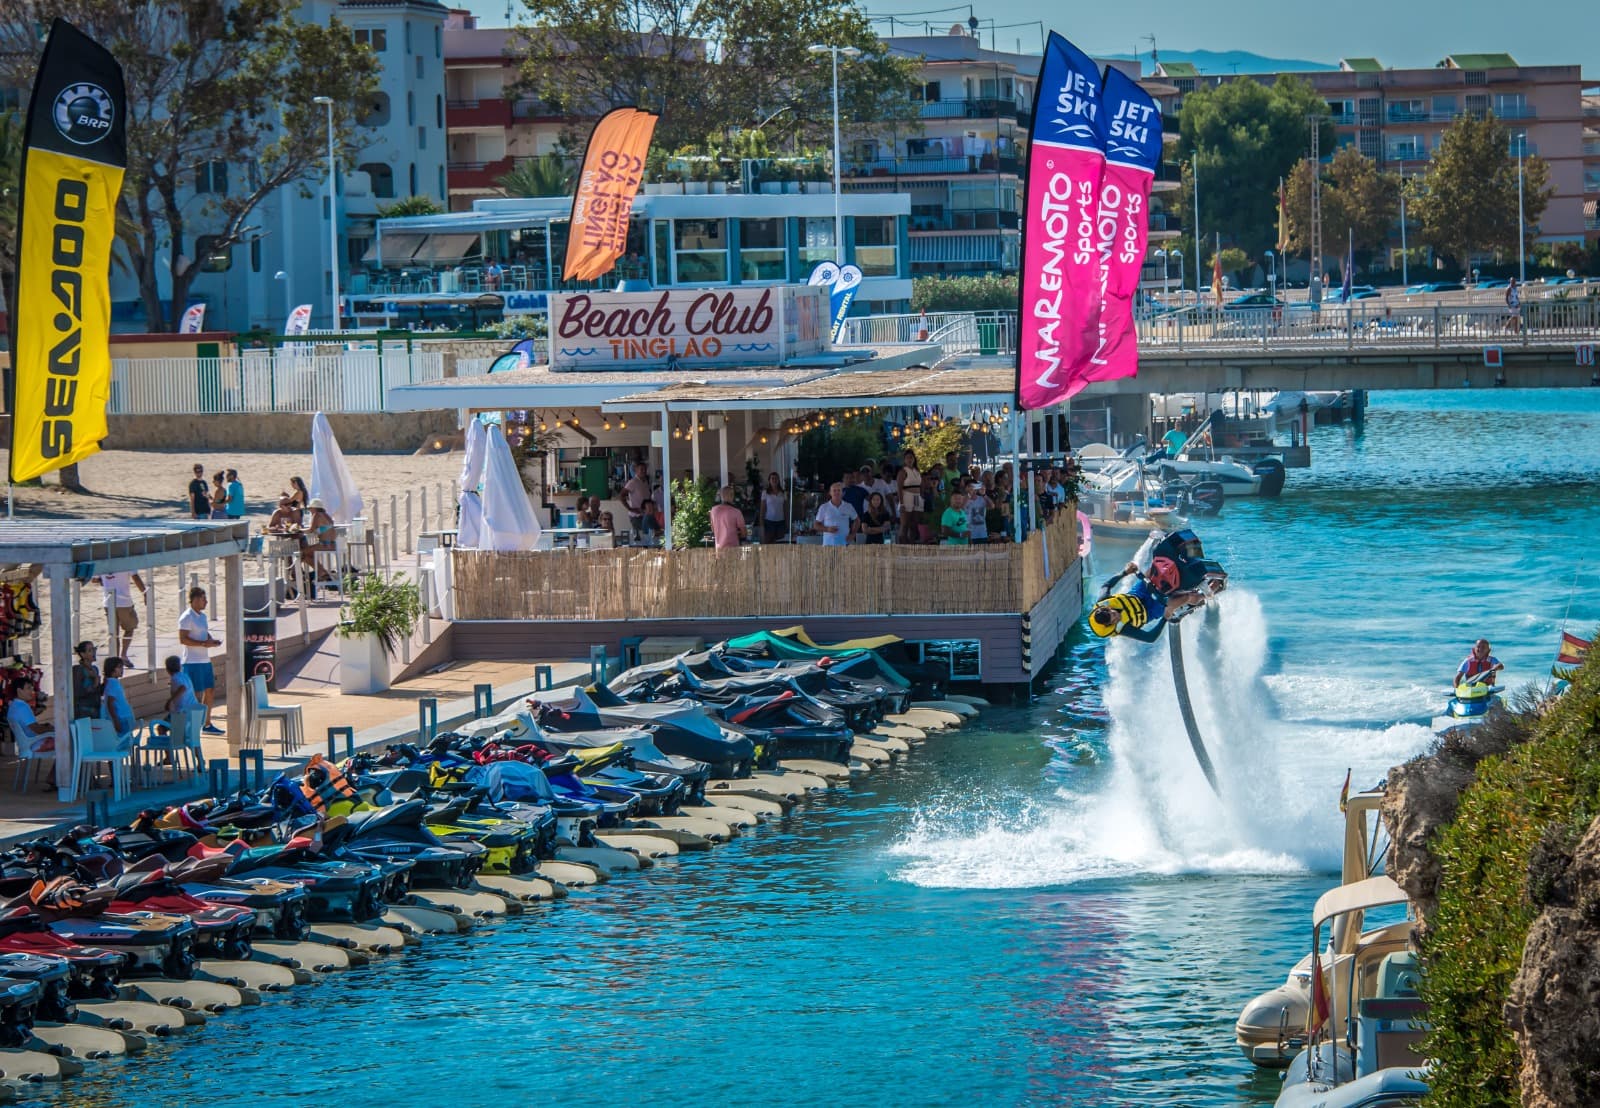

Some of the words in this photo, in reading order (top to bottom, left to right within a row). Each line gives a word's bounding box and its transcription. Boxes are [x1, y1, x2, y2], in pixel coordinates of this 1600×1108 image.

[1060, 69, 1096, 98] JET
[1056, 93, 1097, 122] SKI
[1113, 99, 1154, 123] JET
[76, 114, 110, 129] BRP
[1109, 119, 1149, 145] SKI
[1033, 171, 1073, 390] MAREMOTO
[558, 291, 675, 339] Beach
[685, 288, 773, 335] Club
[609, 337, 722, 360] TINGLAO
